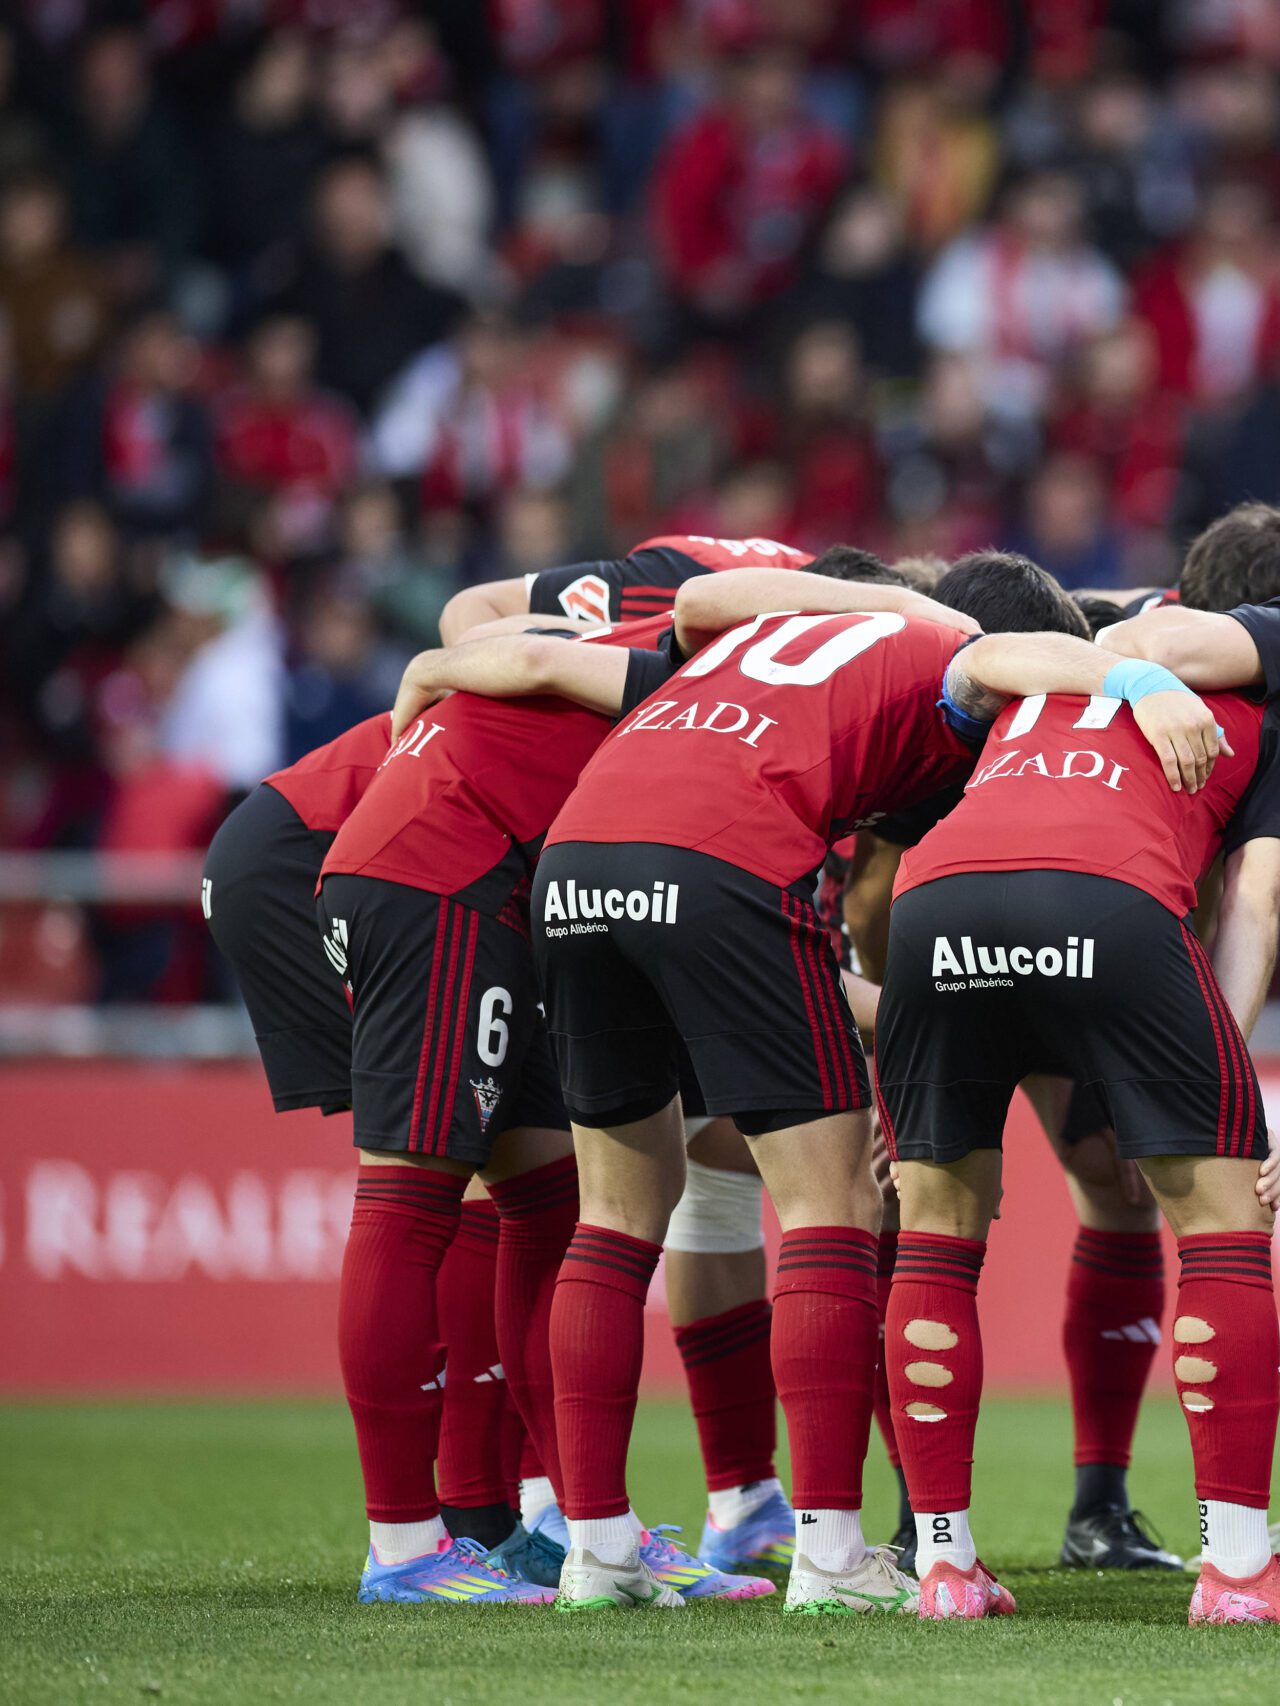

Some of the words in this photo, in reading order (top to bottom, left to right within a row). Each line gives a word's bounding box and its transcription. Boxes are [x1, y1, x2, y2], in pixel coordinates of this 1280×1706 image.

[680, 611, 907, 686] 10
[617, 701, 778, 748] IZADI
[963, 750, 1130, 793] IZADI
[544, 879, 679, 924] Alucoil
[545, 926, 569, 938] Grupo
[570, 922, 608, 935] Alibérico
[932, 936, 1095, 979] Alucoil
[935, 981, 966, 992] Grupo
[969, 977, 1014, 989] Alibérico
[477, 986, 513, 1067] 6
